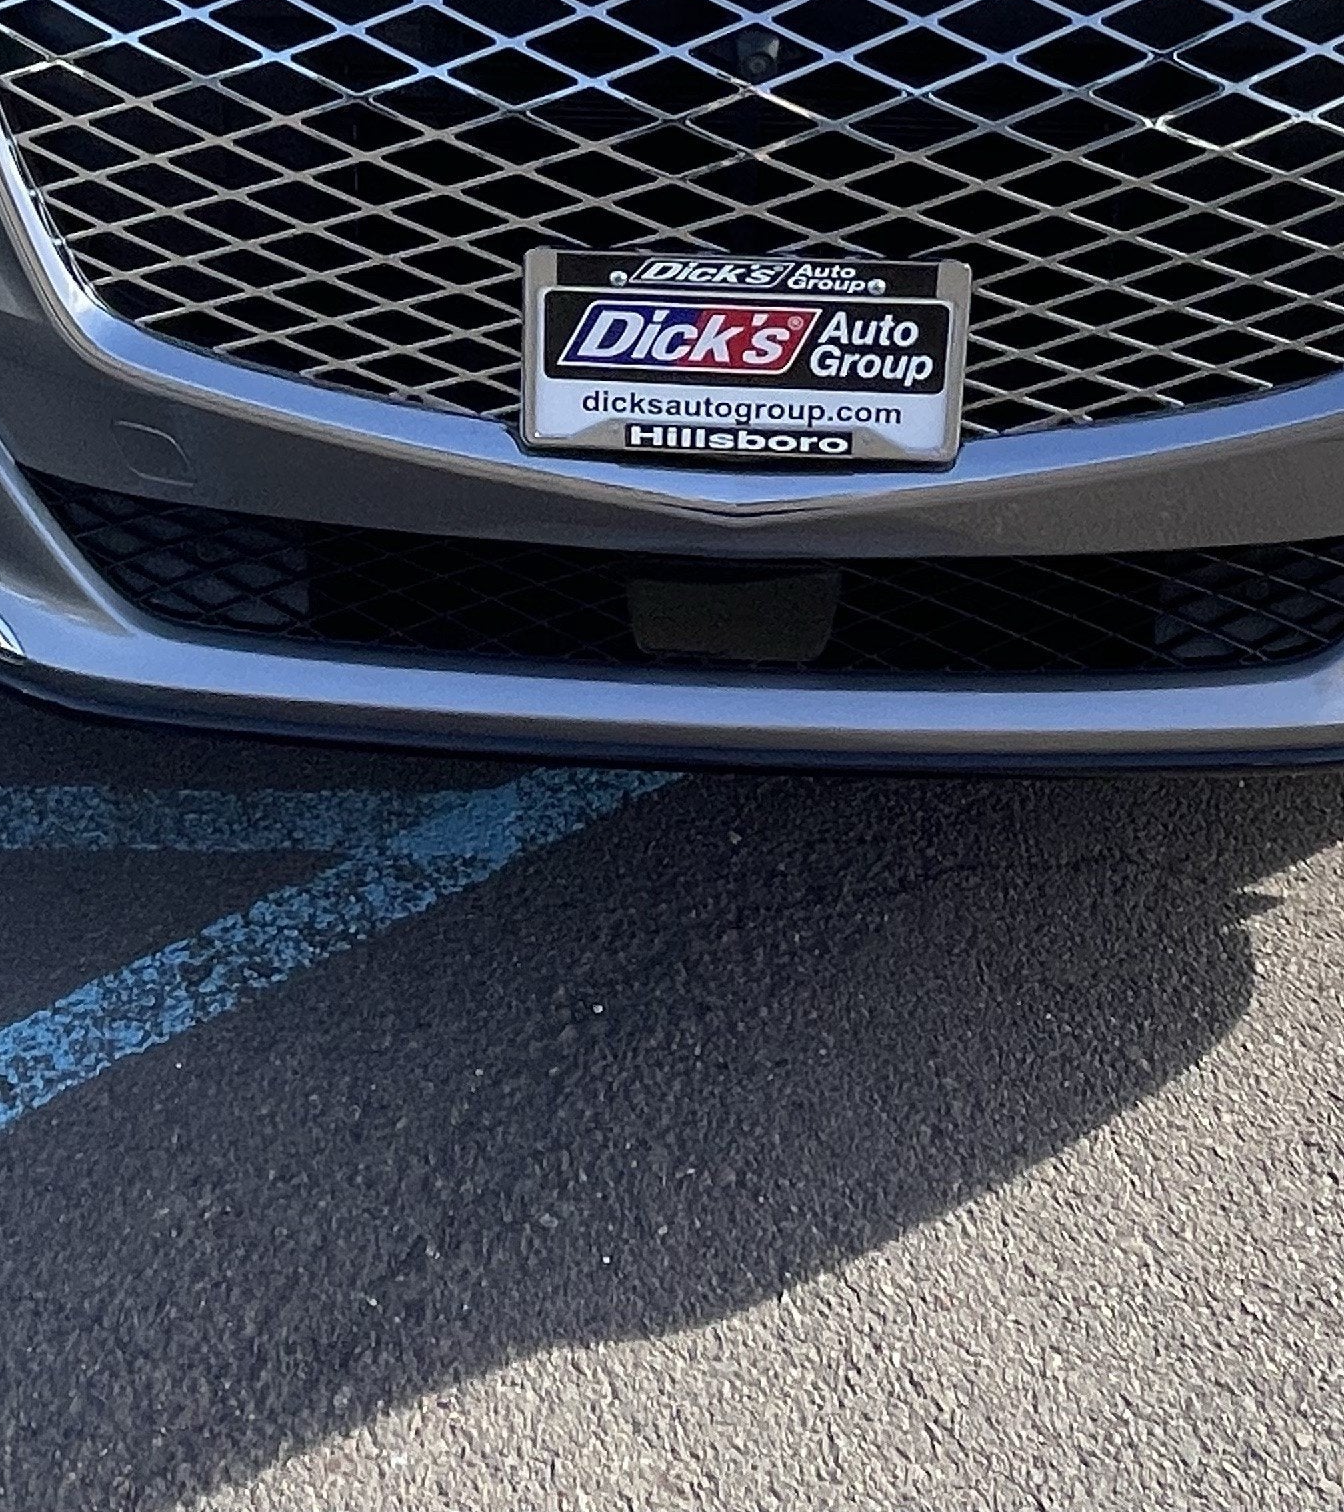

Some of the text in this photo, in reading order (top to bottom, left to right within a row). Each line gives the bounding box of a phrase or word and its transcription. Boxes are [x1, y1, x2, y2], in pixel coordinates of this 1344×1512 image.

[640, 260, 856, 285] Dick's Auto
[787, 278, 867, 294] Group
[575, 308, 920, 365] Dick's Auto
[809, 345, 934, 388] Group
[581, 390, 902, 428] dicksautogroup.com
[629, 424, 849, 455] Hillsboro
